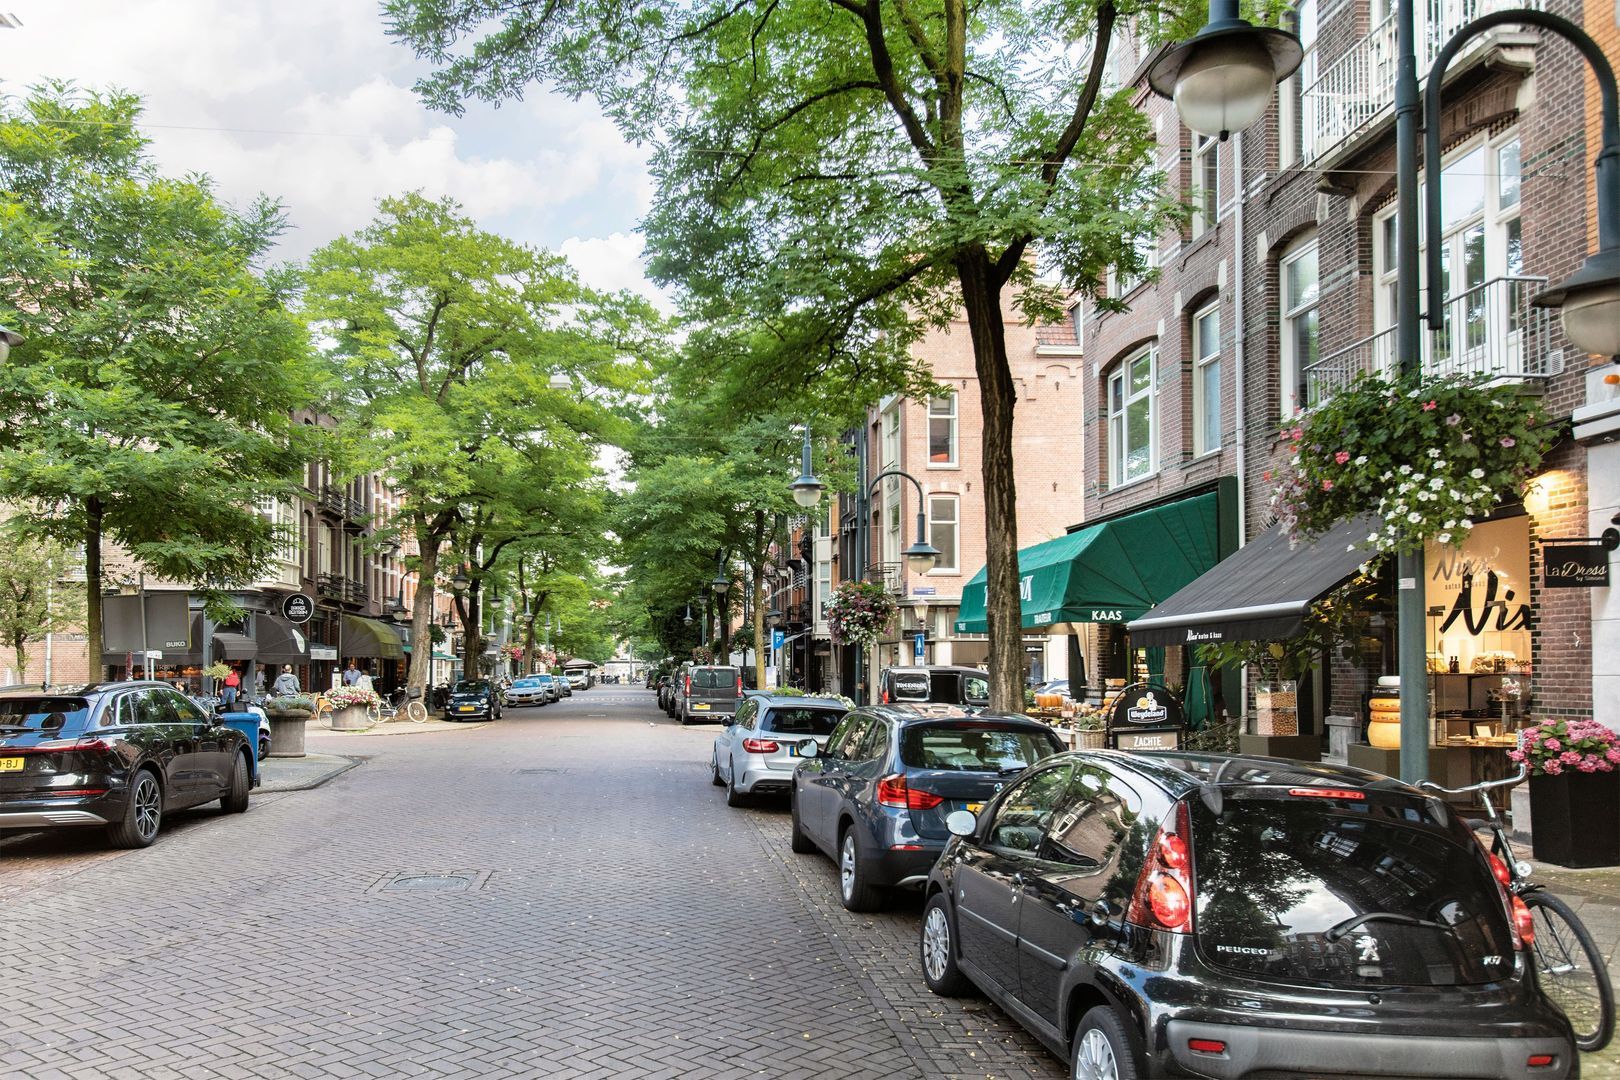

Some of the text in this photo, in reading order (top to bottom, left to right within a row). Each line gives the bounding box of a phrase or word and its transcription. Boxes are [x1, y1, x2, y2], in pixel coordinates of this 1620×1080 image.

[1545, 561, 1608, 578] La Dress
[1091, 610, 1123, 621] KAAS
[776, 635, 782, 644] P
[1133, 736, 1162, 747] ZACHTE
[0, 759, 19, 769] -BJ
[1216, 945, 1274, 955] PEUGEOT
[1482, 955, 1502, 966] 107
